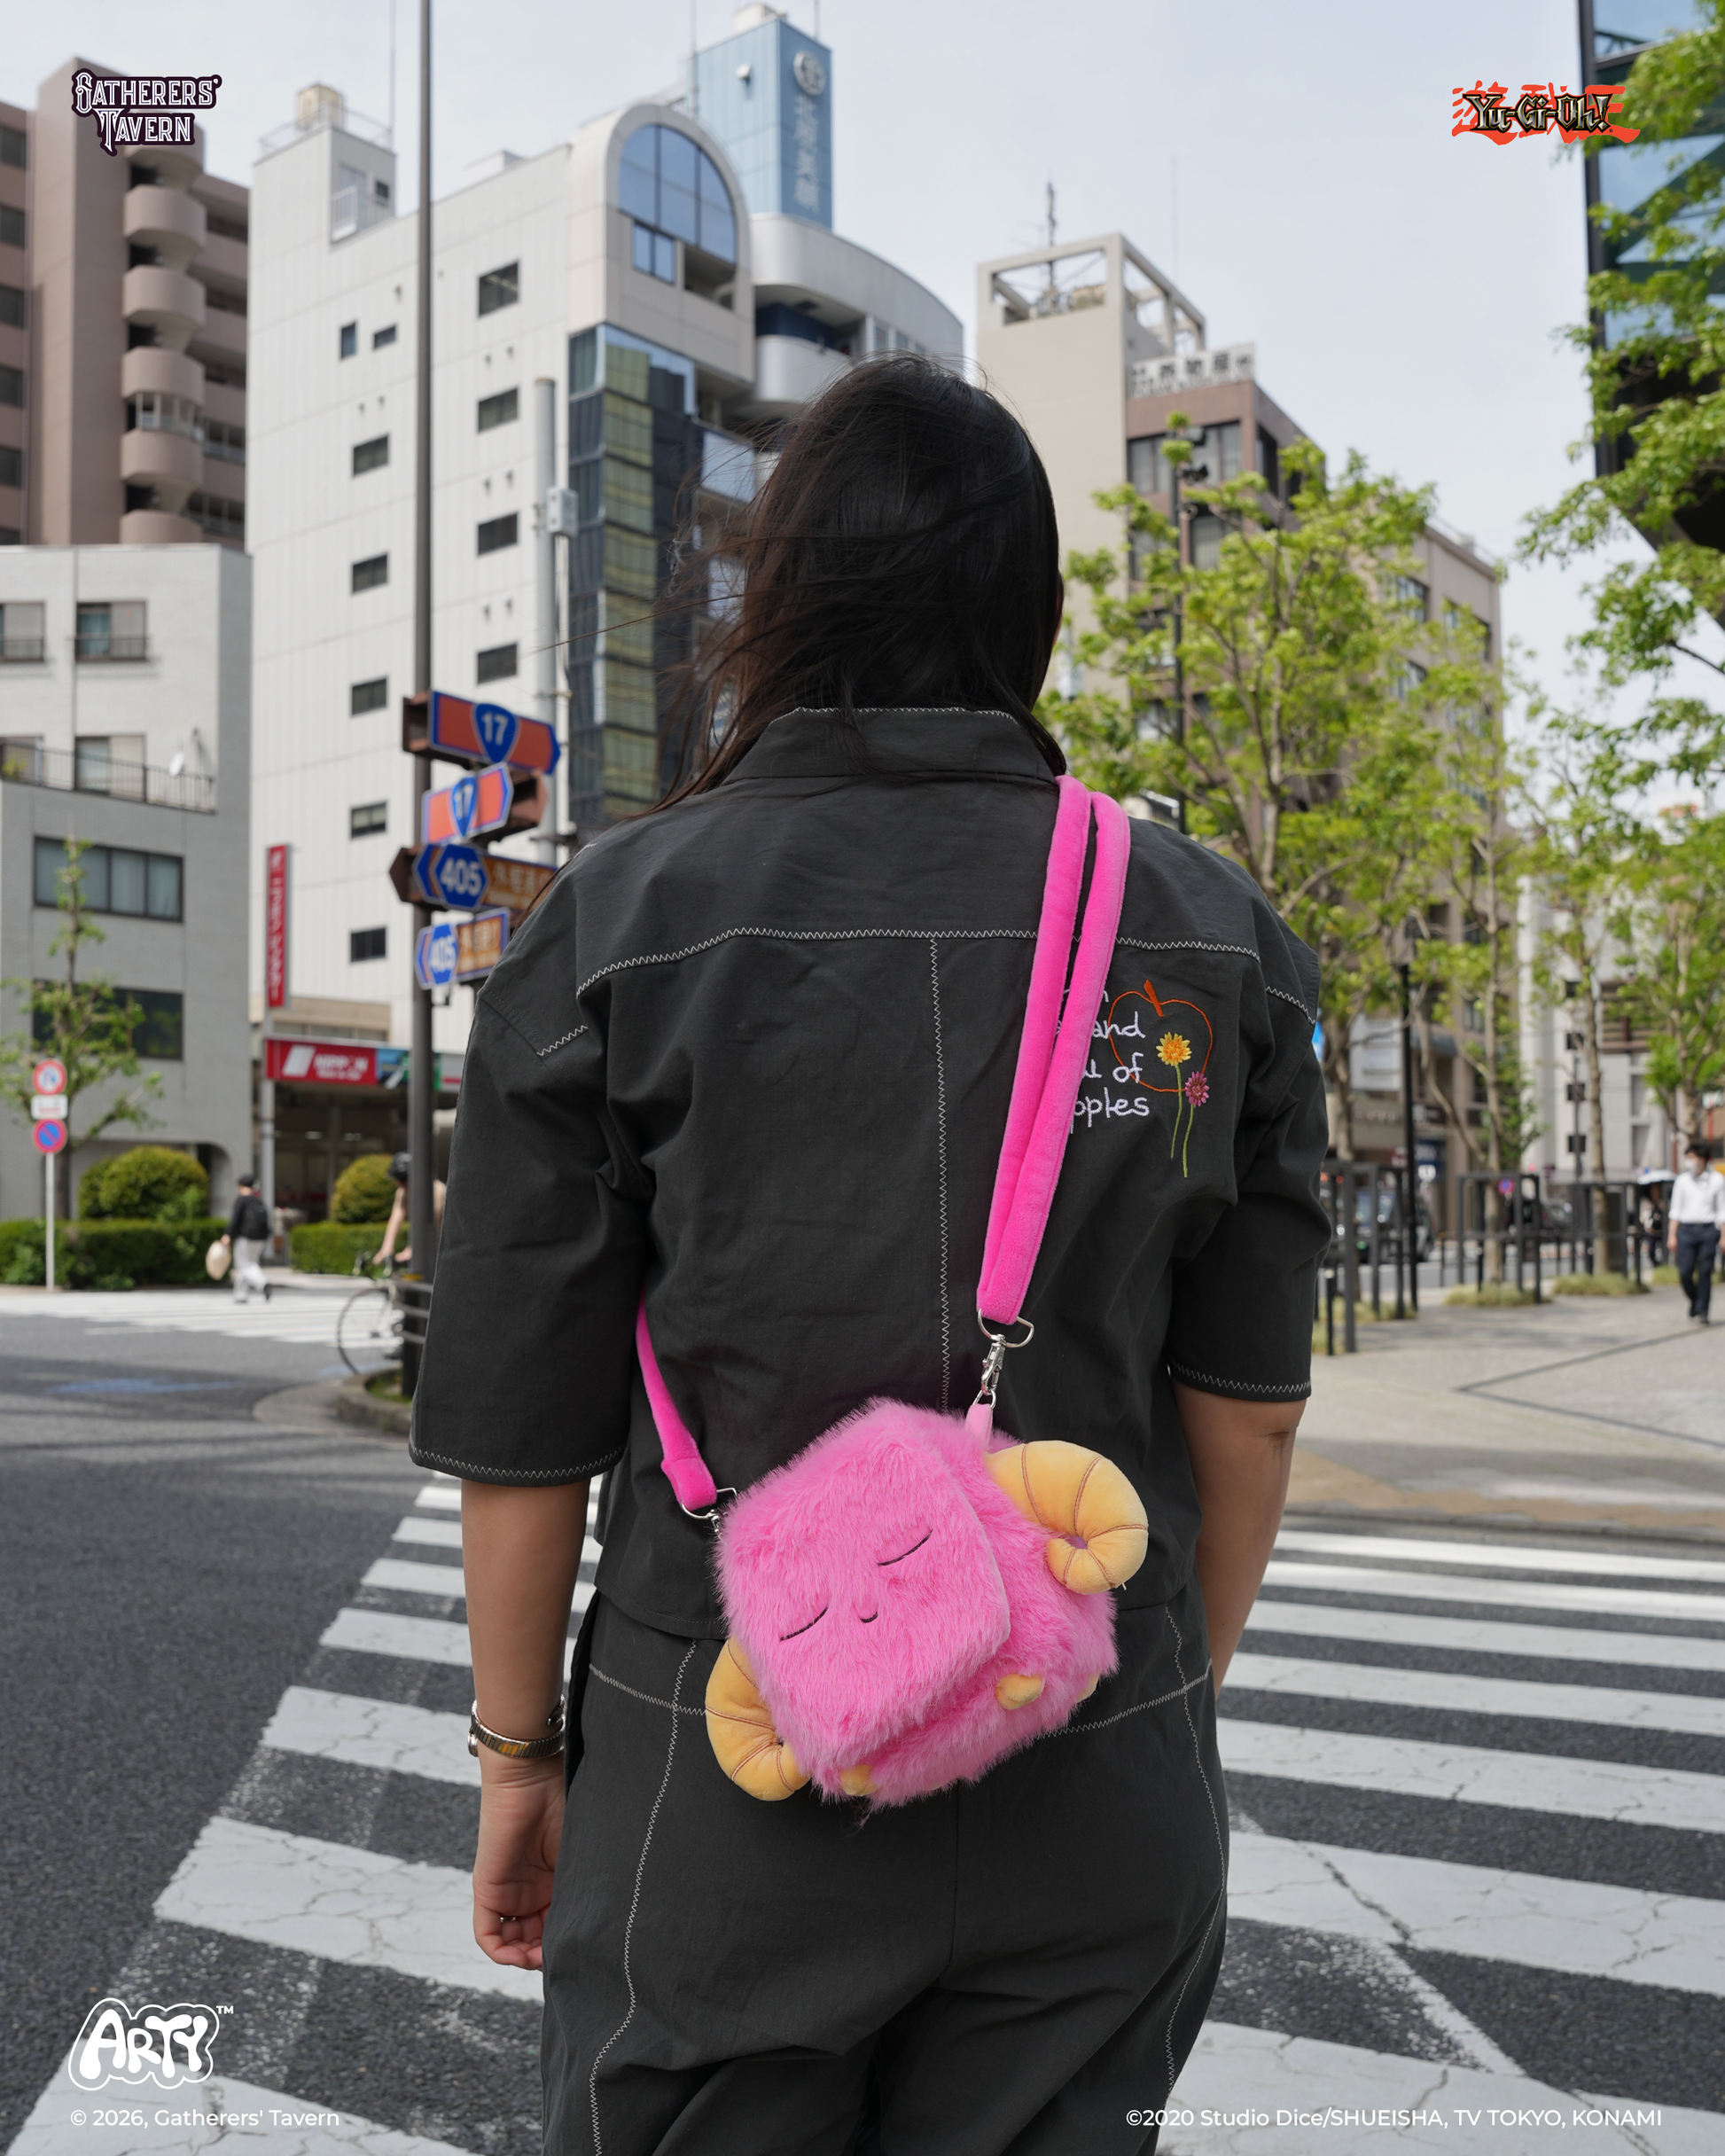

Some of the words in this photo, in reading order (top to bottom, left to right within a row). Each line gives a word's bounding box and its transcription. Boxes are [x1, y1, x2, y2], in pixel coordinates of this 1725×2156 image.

[483, 713, 509, 746] 17
[455, 784, 474, 819] 17
[440, 857, 484, 896] 405
[429, 935, 456, 973] 405
[1112, 1051, 1143, 1083] of
[1071, 1087, 1150, 1134] pples
